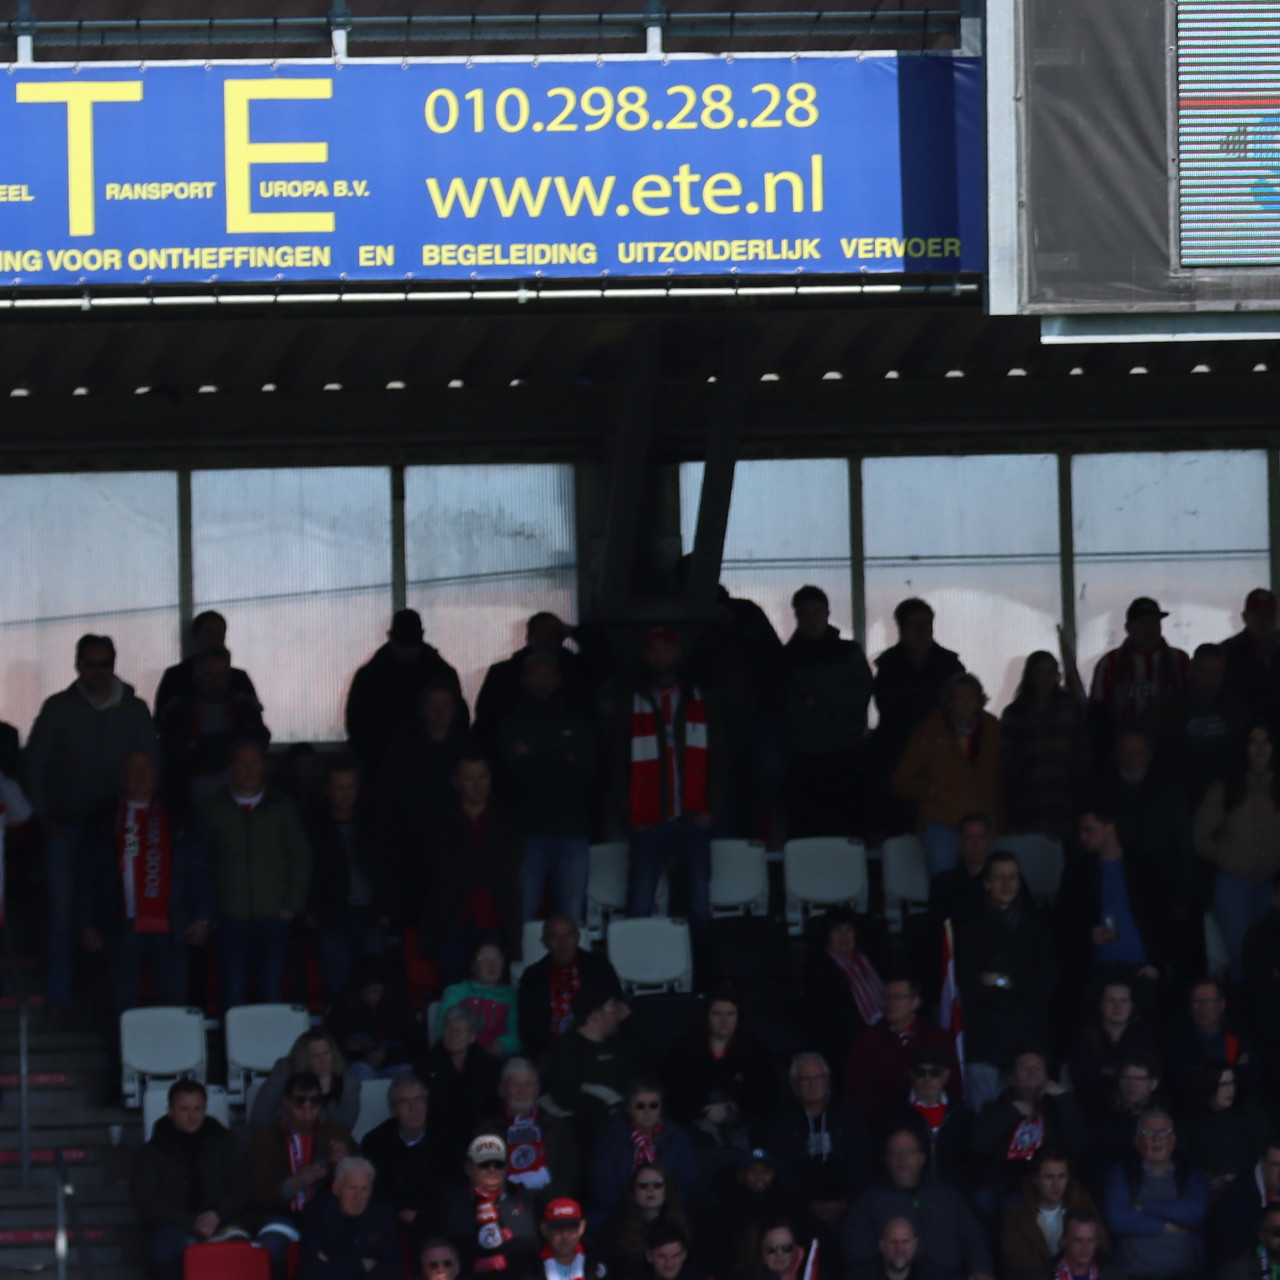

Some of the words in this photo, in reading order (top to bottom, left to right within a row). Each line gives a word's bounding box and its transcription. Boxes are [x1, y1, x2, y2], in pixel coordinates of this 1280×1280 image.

[424, 81, 819, 134] 010.298.28.28
[105, 181, 217, 200] RANSPORT
[259, 180, 329, 199] UROPA
[333, 180, 371, 198] B.V.
[426, 154, 823, 218] www.ete.nl
[46, 248, 122, 272] VOOR
[128, 246, 331, 271] ONTHEFFINGEN
[359, 245, 395, 267] EN
[422, 242, 598, 266] BEGELEIDING
[617, 238, 822, 264] UITZONDERLIJK
[841, 238, 962, 260] VERVOER
